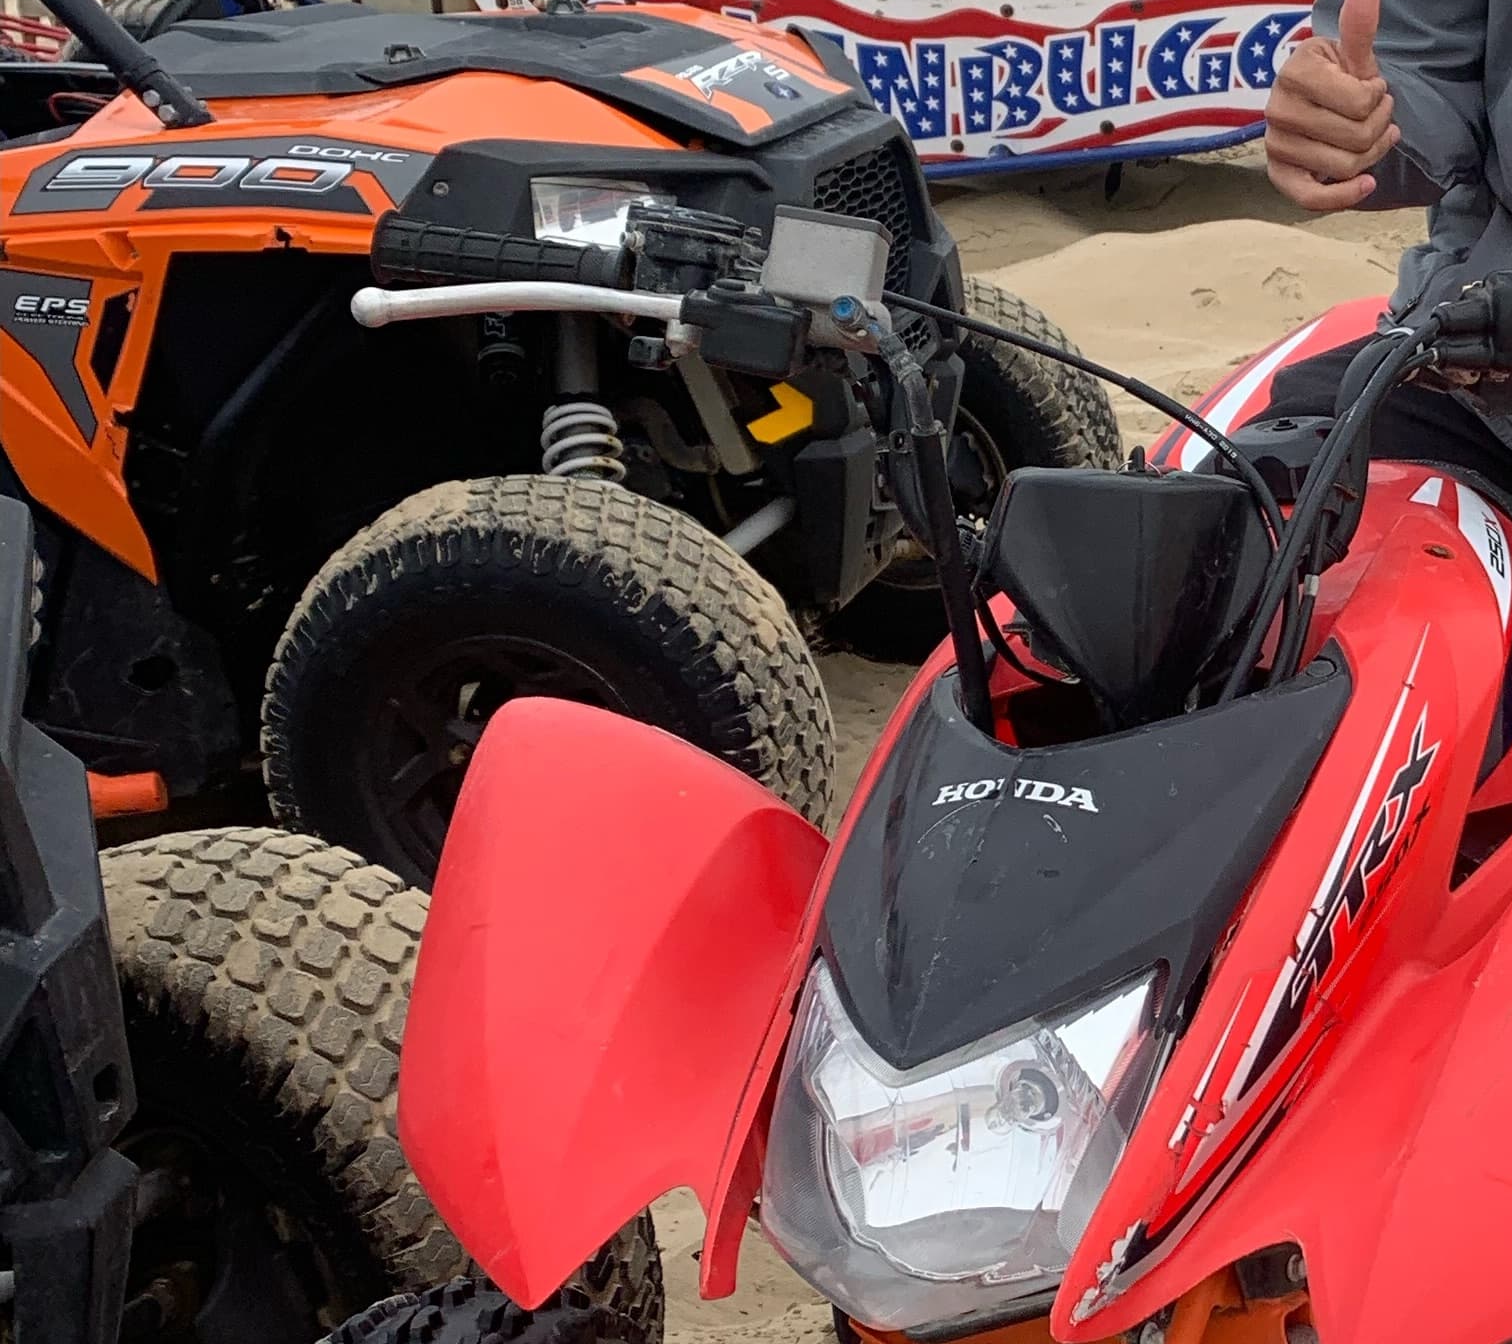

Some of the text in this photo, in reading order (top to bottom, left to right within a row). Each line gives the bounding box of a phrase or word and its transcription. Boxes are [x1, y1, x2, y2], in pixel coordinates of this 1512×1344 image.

[286, 144, 411, 164] DOHC
[44, 155, 356, 193] 900
[14, 295, 90, 315] EPS
[1481, 511, 1506, 579] 250X
